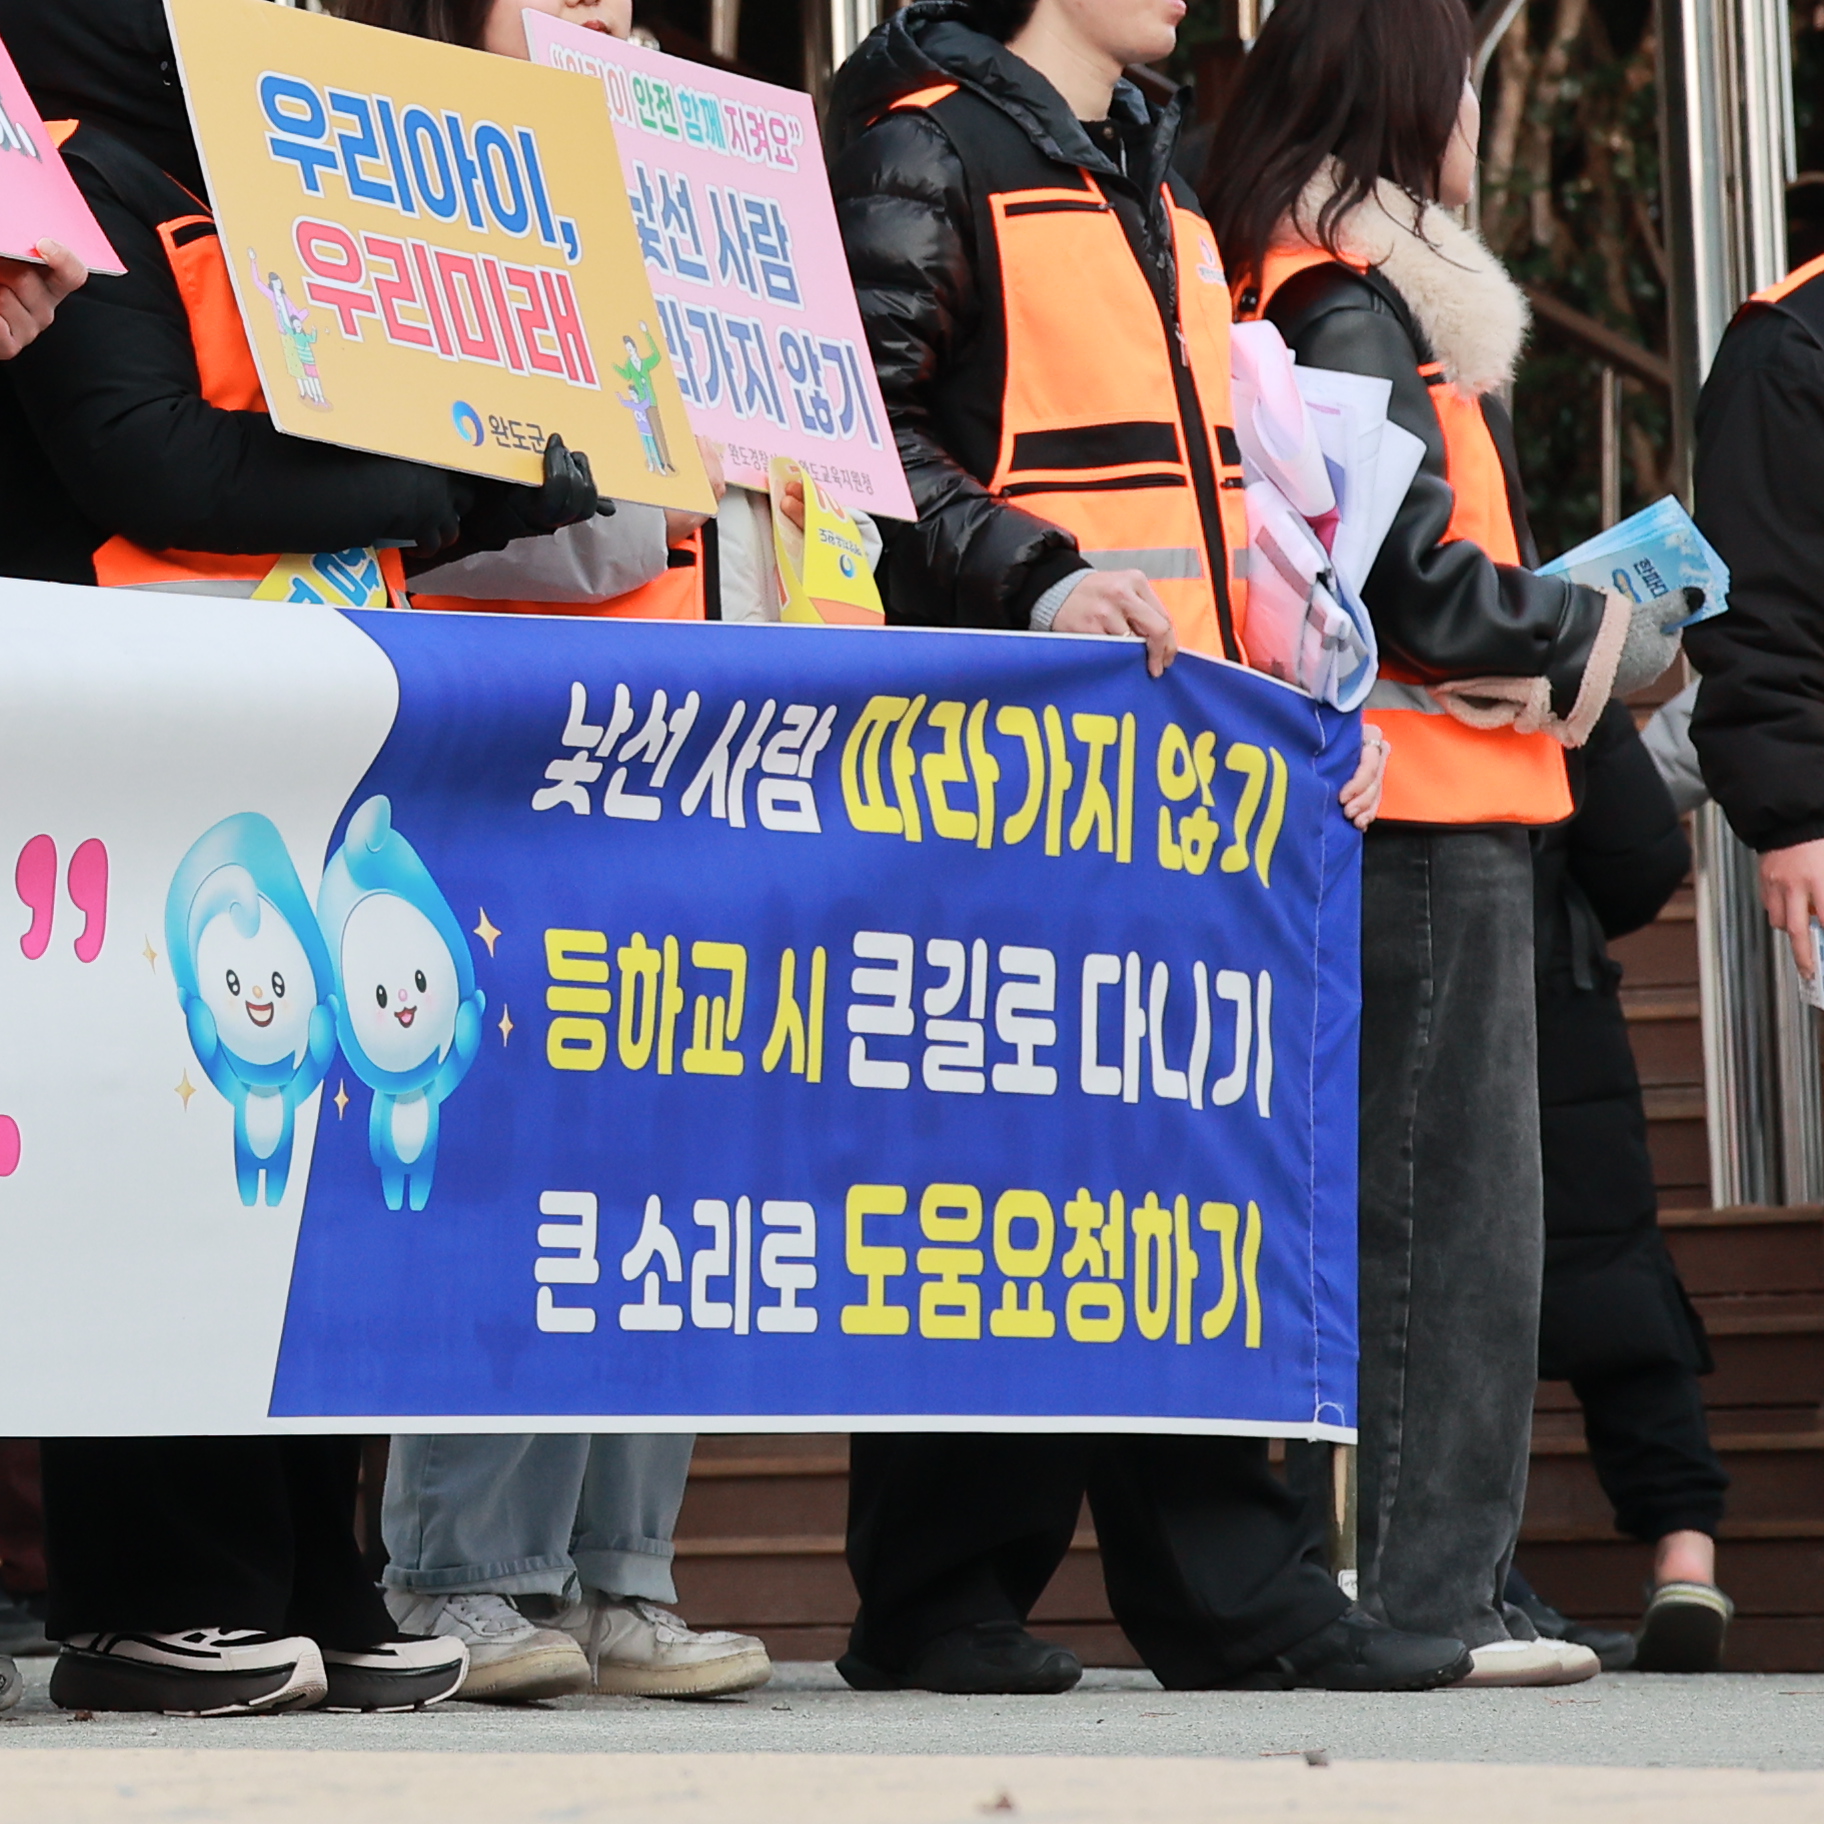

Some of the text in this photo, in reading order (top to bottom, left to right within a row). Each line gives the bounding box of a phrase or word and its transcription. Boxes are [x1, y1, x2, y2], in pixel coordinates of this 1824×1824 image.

[256, 71, 584, 265] 우리아이,
[630, 75, 682, 136] 안전
[677, 90, 728, 150] 함께
[292, 216, 602, 392] 우리미래
[708, 189, 801, 304] 사람
[488, 414, 546, 454] 완도군
[778, 329, 882, 446] 않기
[530, 680, 1289, 890] 낯선 사람 따라가지 않기
[542, 926, 1273, 1120] 등하교 시 큰길로 다니기
[533, 1182, 1264, 1351] 큰 소리로 도움요청하기
